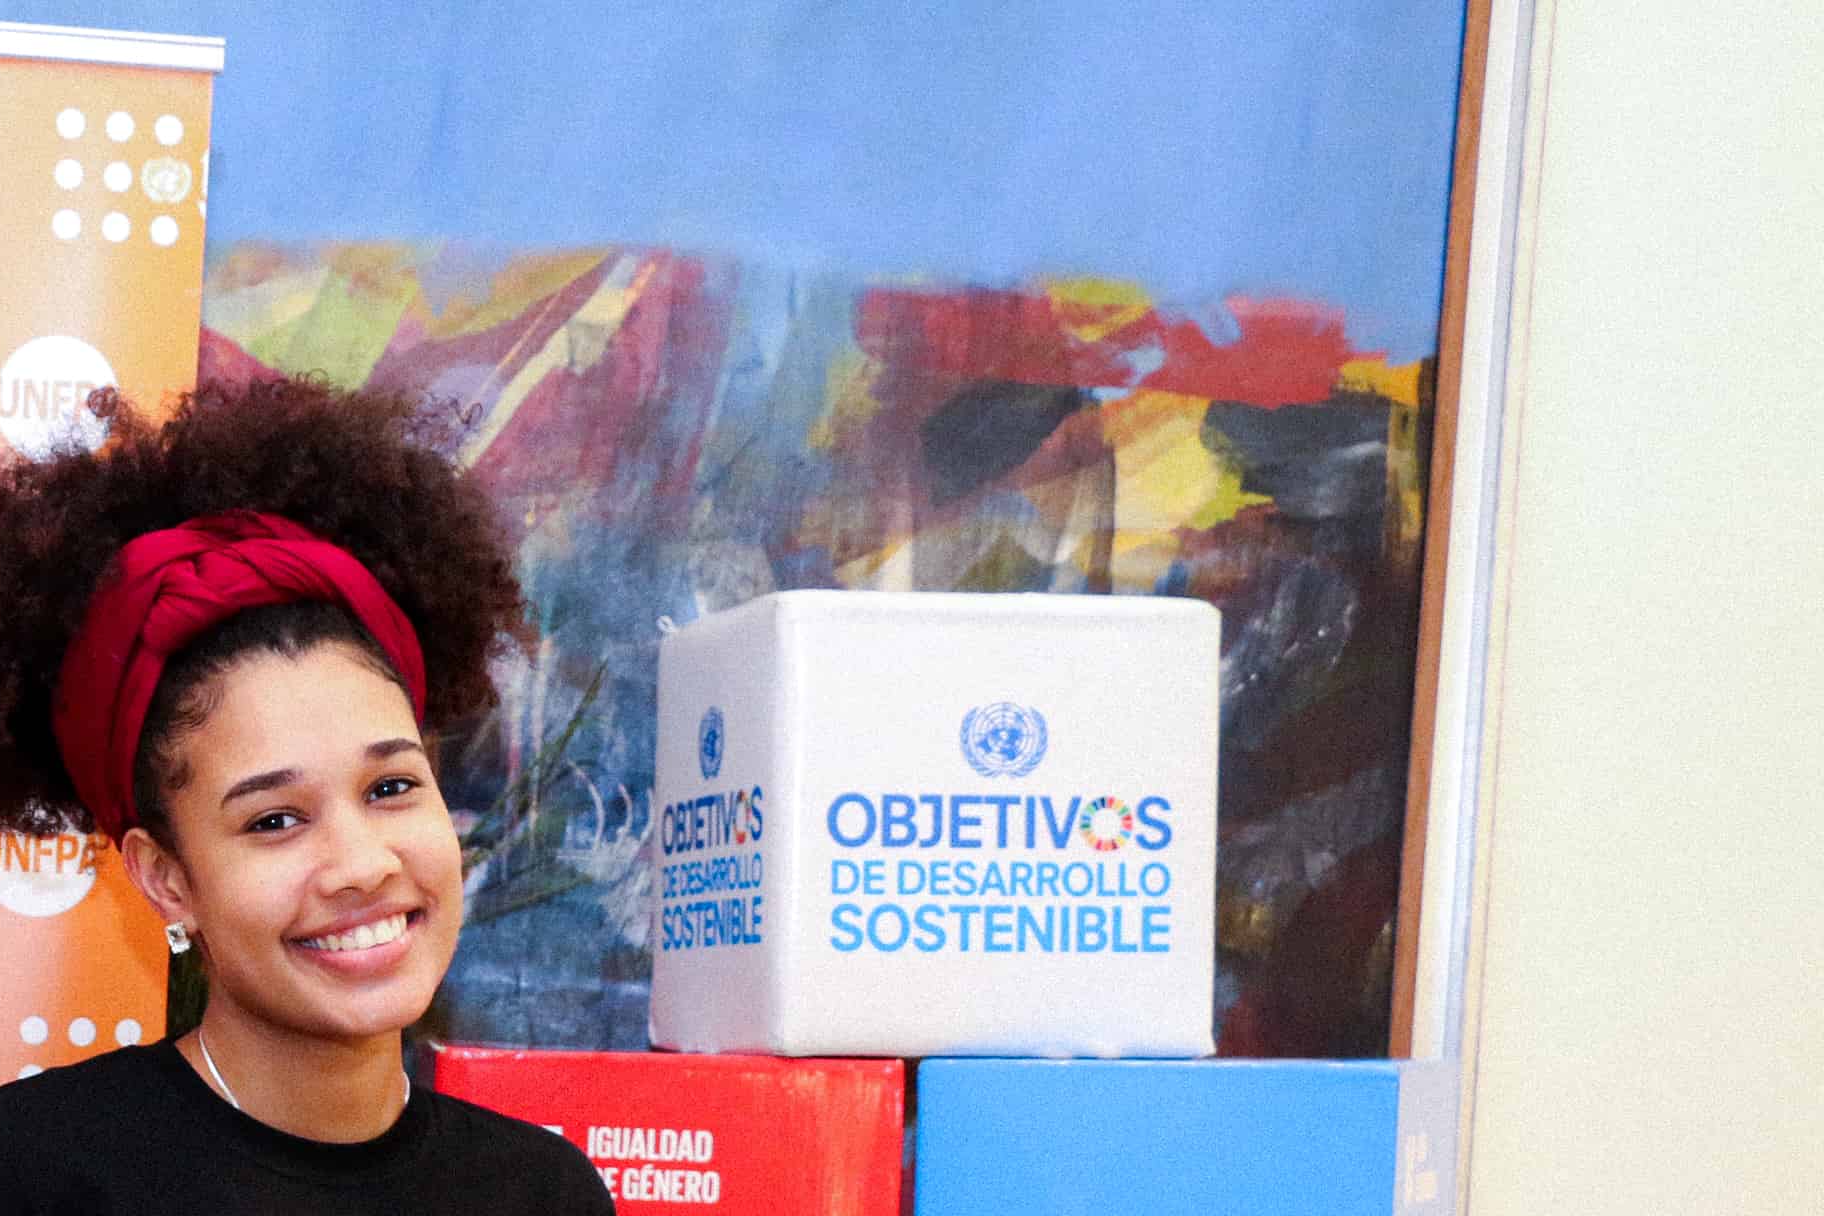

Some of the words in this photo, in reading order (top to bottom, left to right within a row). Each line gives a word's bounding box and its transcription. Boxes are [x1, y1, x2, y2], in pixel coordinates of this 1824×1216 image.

[662, 785, 763, 856] OBJETIVOS
[827, 793, 1172, 851] OBJETIVOS
[831, 860, 884, 895] DE
[897, 861, 1170, 898] DESARROLLO
[662, 895, 763, 951] SOSTENIBLE
[830, 903, 1170, 953] SOSTENIBLE
[587, 1125, 714, 1163] IGUALDAD
[622, 1163, 721, 1204] GÉNERO
